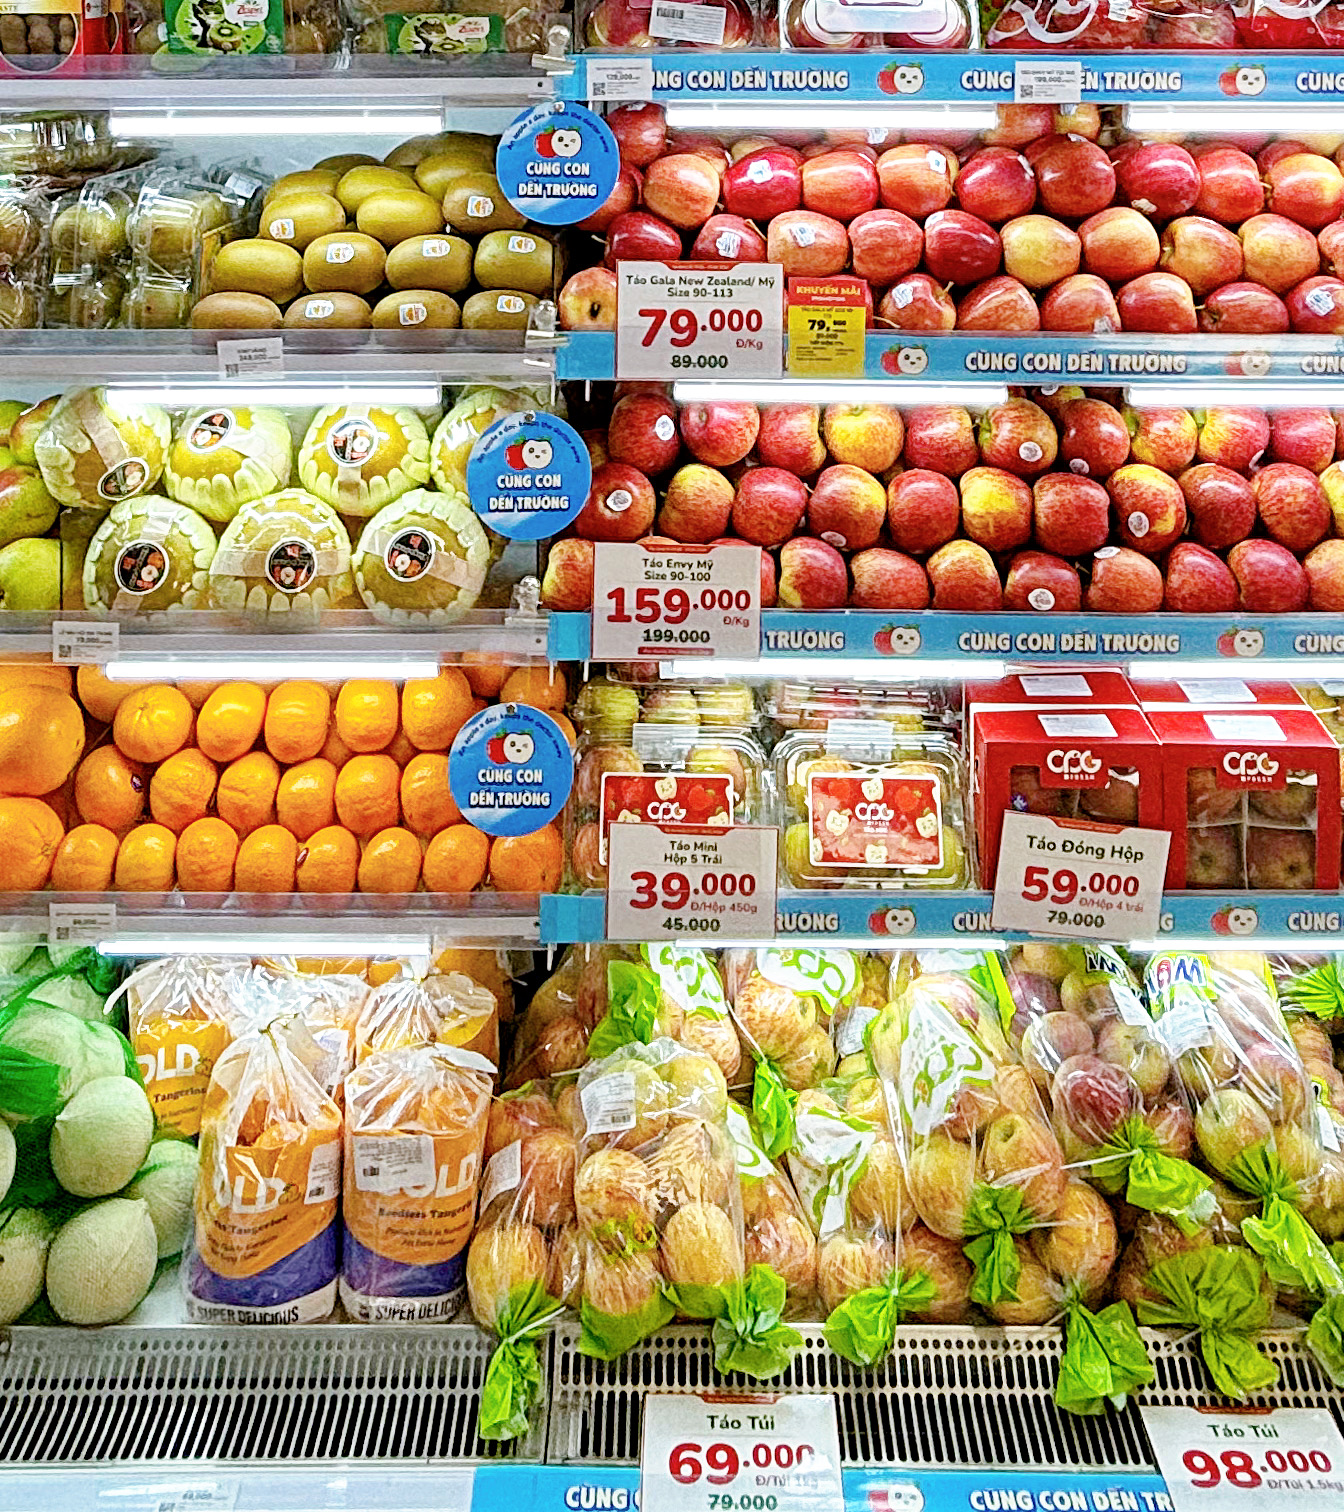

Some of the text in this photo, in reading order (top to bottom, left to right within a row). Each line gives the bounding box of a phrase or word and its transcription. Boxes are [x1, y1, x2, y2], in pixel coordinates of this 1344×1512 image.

[564, 162, 590, 176] CON
[627, 275, 776, 288] Táo Gala New Zealand/ Mỹ
[667, 288, 733, 298] Size 90-113
[638, 308, 763, 348] 79.000
[736, 339, 763, 351] Đ/Kg
[671, 355, 728, 368] 89.000
[642, 558, 714, 570] Táo Envy Mỹ
[644, 571, 711, 582] Size 90-100
[606, 587, 751, 625] 159.000
[723, 615, 750, 628] Đ/Kg
[643, 629, 711, 643] 199.000
[670, 841, 718, 852] Táo Mini
[1026, 835, 1145, 865] Táo Đóng Hộp
[664, 853, 722, 865] Hộp 5 Trái
[629, 871, 756, 910] 39.000
[1021, 865, 1139, 904] 59.000
[690, 902, 758, 914] Đ/Hộp 450g
[663, 917, 720, 932] 45.000
[1047, 910, 1104, 928] 79.000
[197, 1306, 235, 1323] SUPER
[375, 1304, 415, 1321] SUPER
[706, 1415, 775, 1431] Táo Túi
[1208, 1424, 1279, 1439] Táo Túi
[1182, 1449, 1332, 1489] 98.000
[708, 1493, 778, 1511] 79.000
